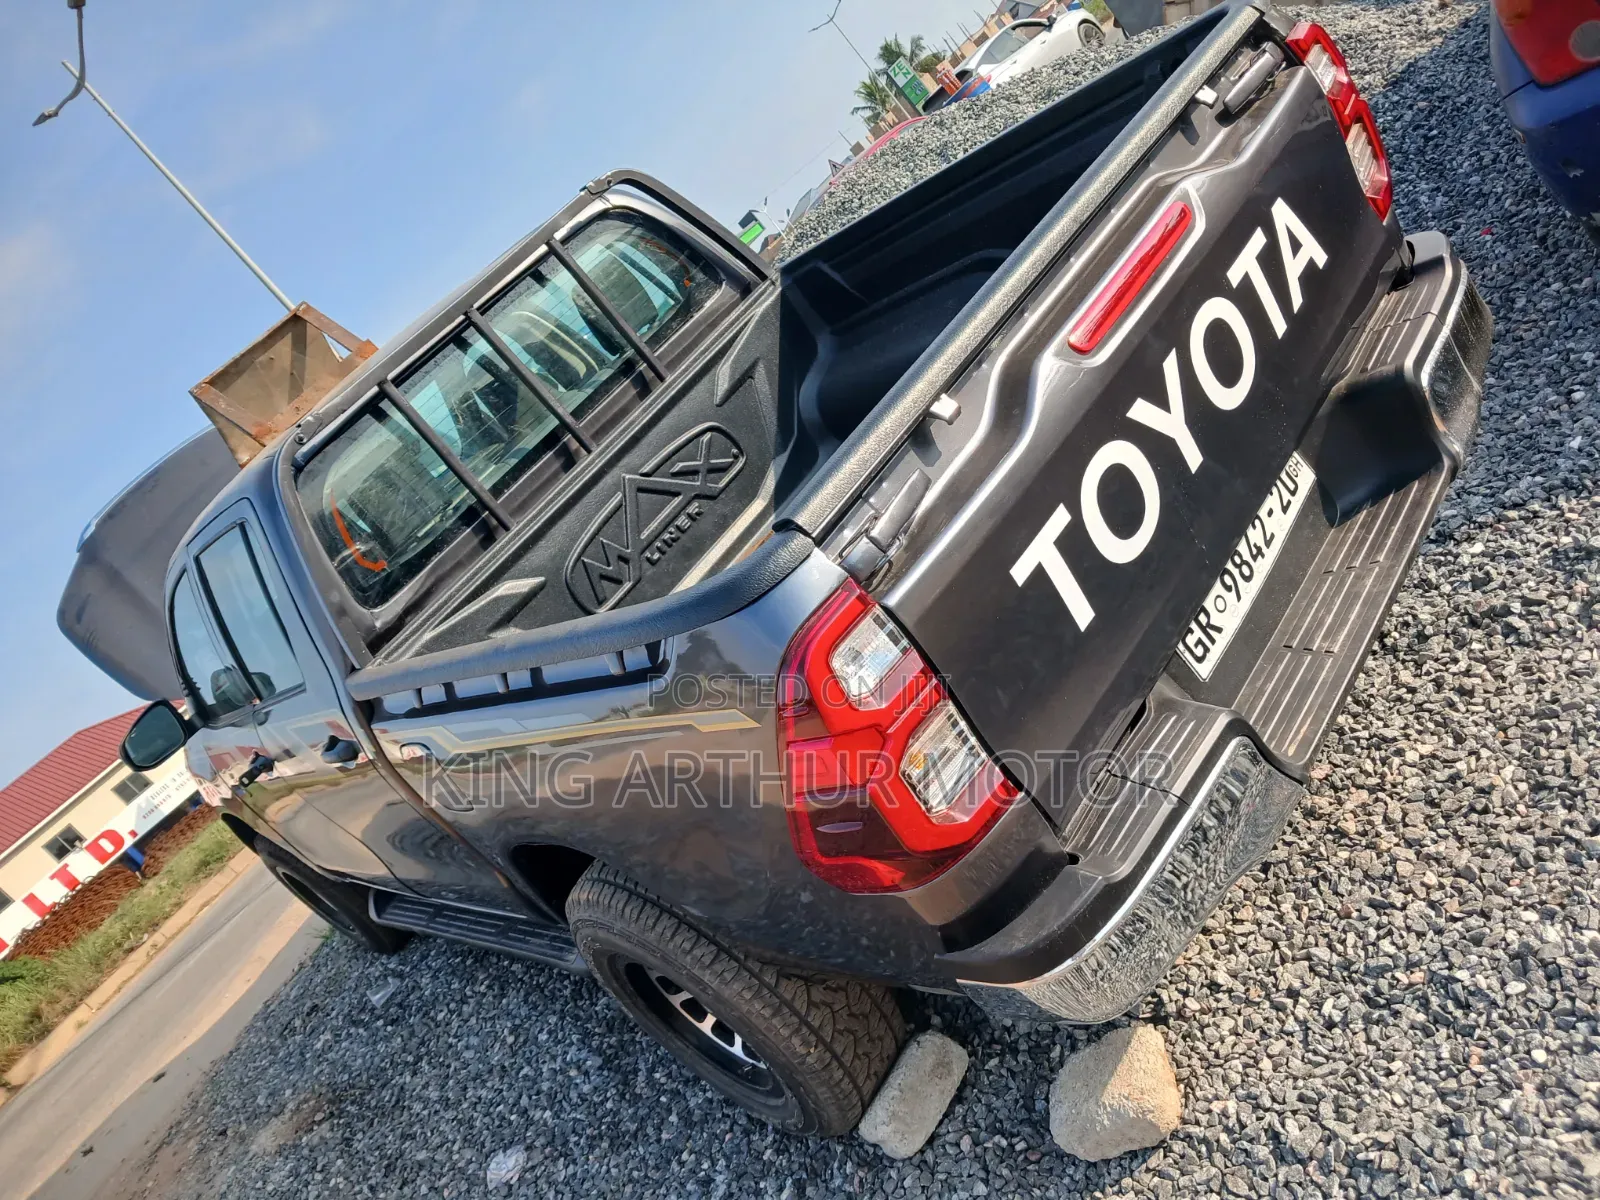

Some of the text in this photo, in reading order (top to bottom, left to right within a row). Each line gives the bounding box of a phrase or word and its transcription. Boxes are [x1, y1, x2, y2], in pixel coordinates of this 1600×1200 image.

[1009, 197, 1328, 632] TOYOTA
[581, 432, 735, 605] MAX
[645, 502, 704, 566] LINER
[1181, 605, 1223, 664] GR
[22, 829, 138, 919] LTD.
